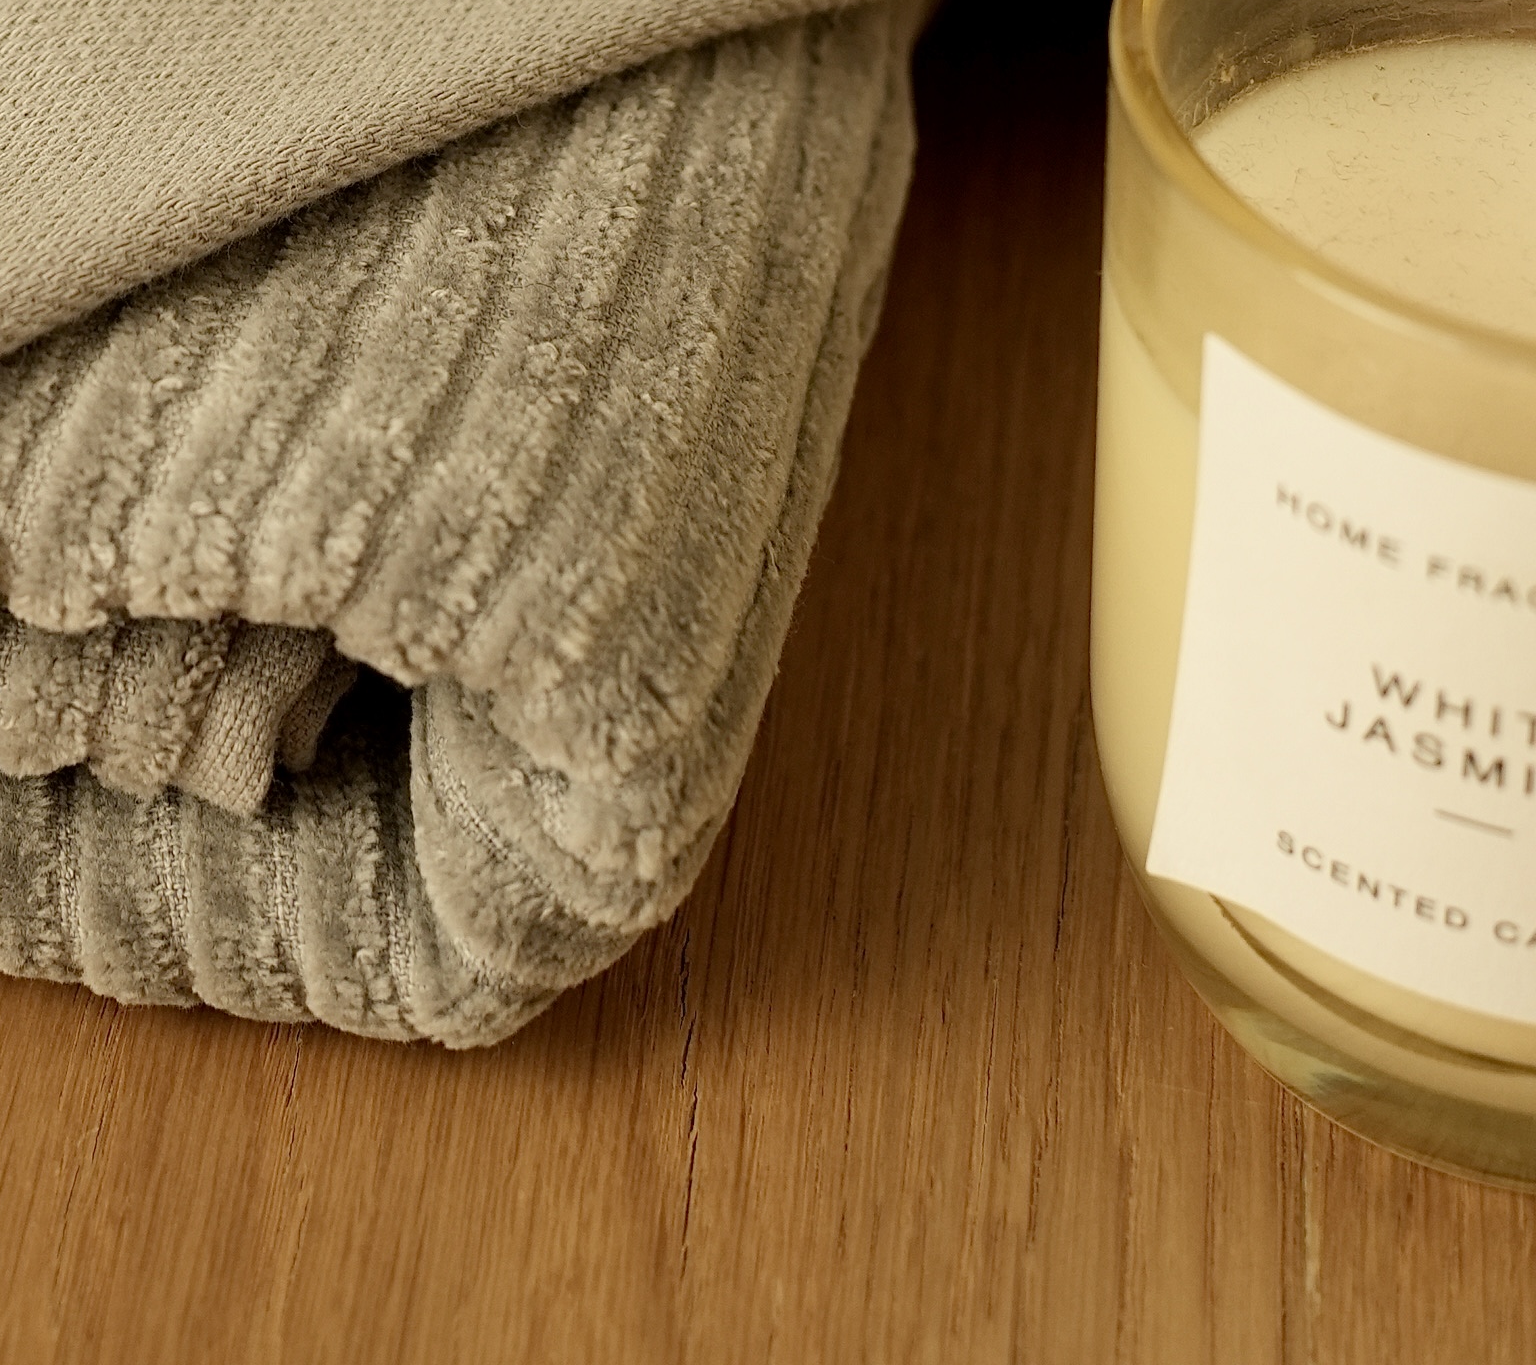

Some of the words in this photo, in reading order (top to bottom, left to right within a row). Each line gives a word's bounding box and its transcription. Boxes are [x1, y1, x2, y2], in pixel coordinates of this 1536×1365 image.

[1275, 482, 1403, 567] HOME
[1324, 699, 1536, 795] JASMI
[1370, 662, 1536, 747] WHIT
[1276, 829, 1469, 930] SCENTED
